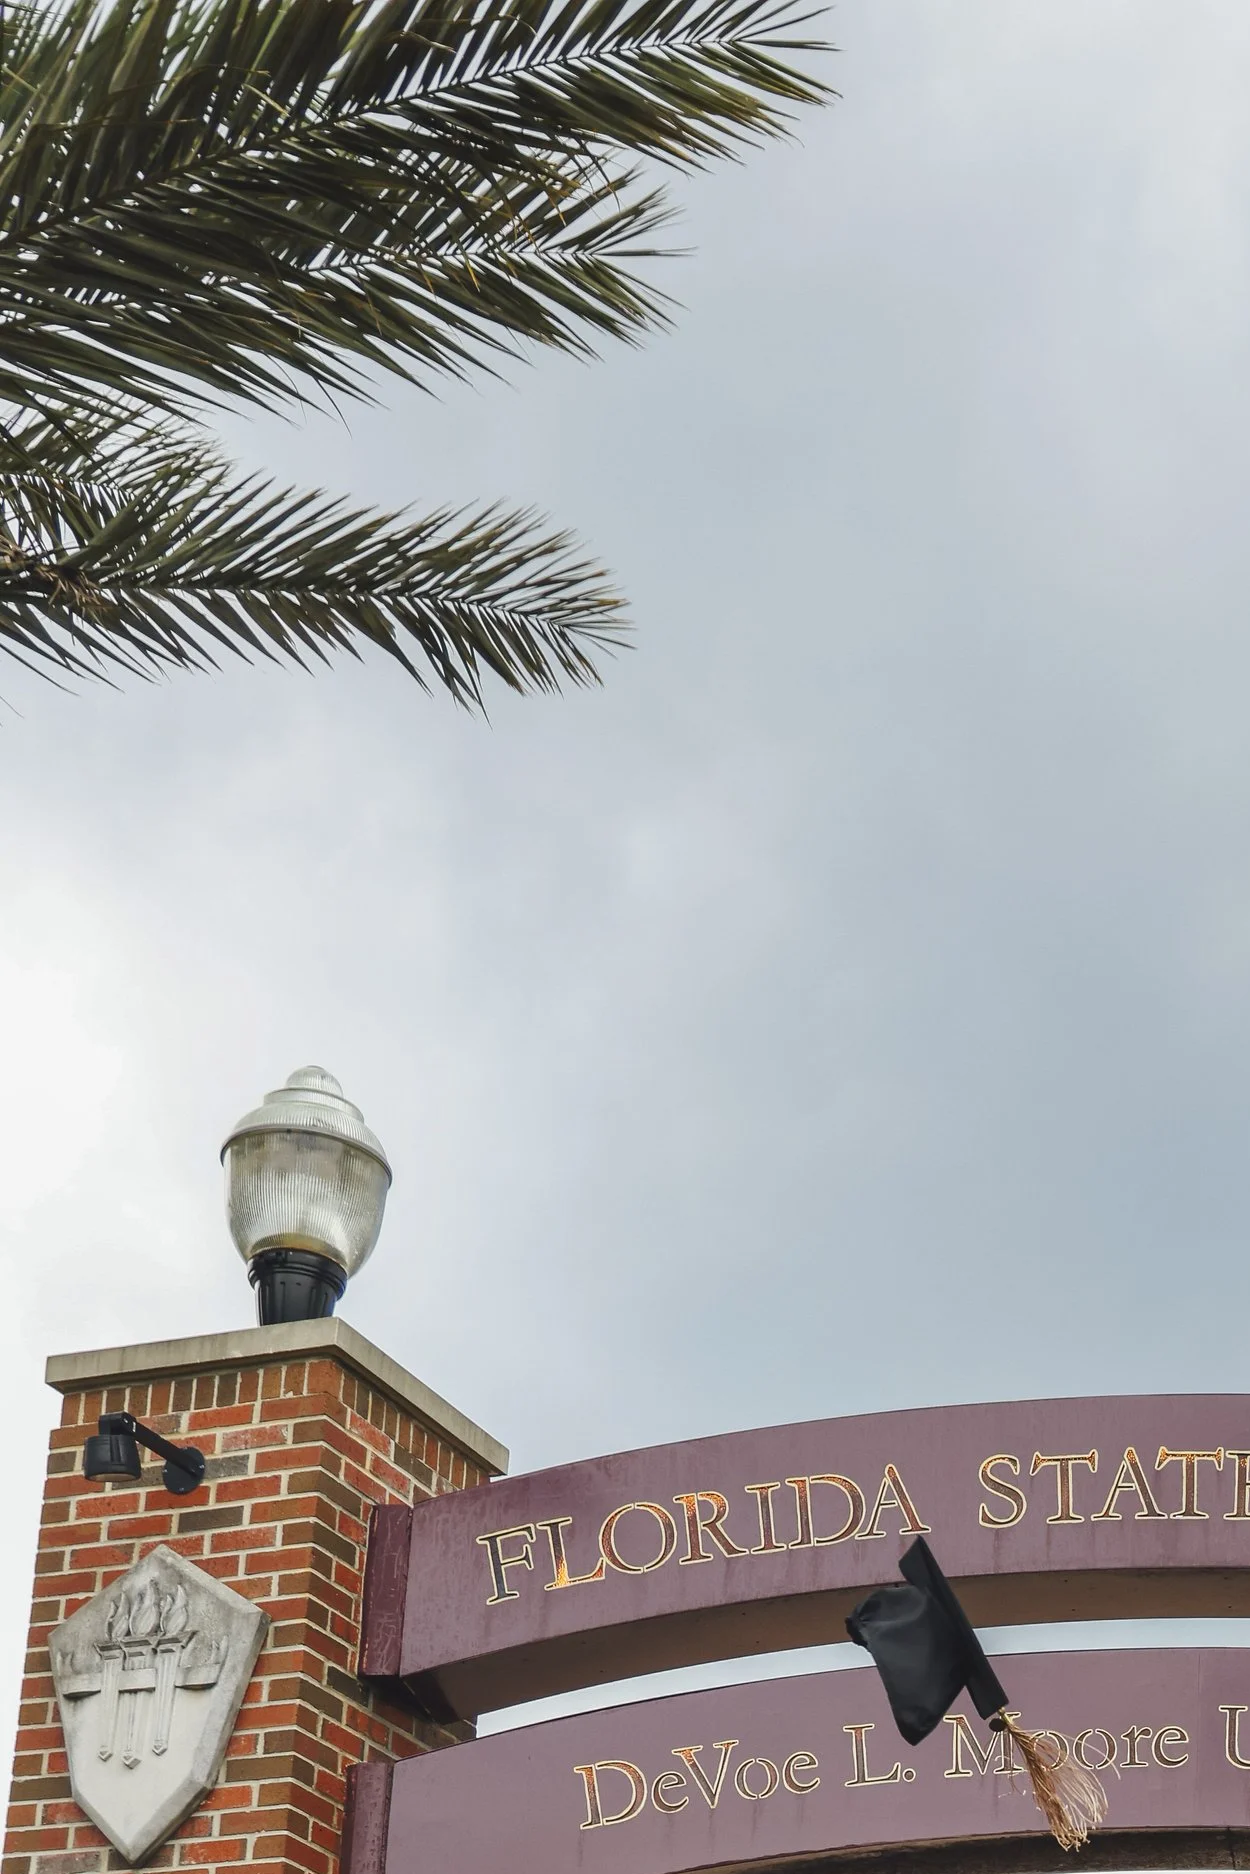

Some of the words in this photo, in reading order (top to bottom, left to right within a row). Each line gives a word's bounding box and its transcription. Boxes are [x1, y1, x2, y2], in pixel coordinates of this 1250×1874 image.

[476, 1463, 931, 1605] FLORIDA
[578, 1739, 820, 1830] DeVoe
[844, 1723, 916, 1787] L.
[944, 1711, 1189, 1779] Moore
